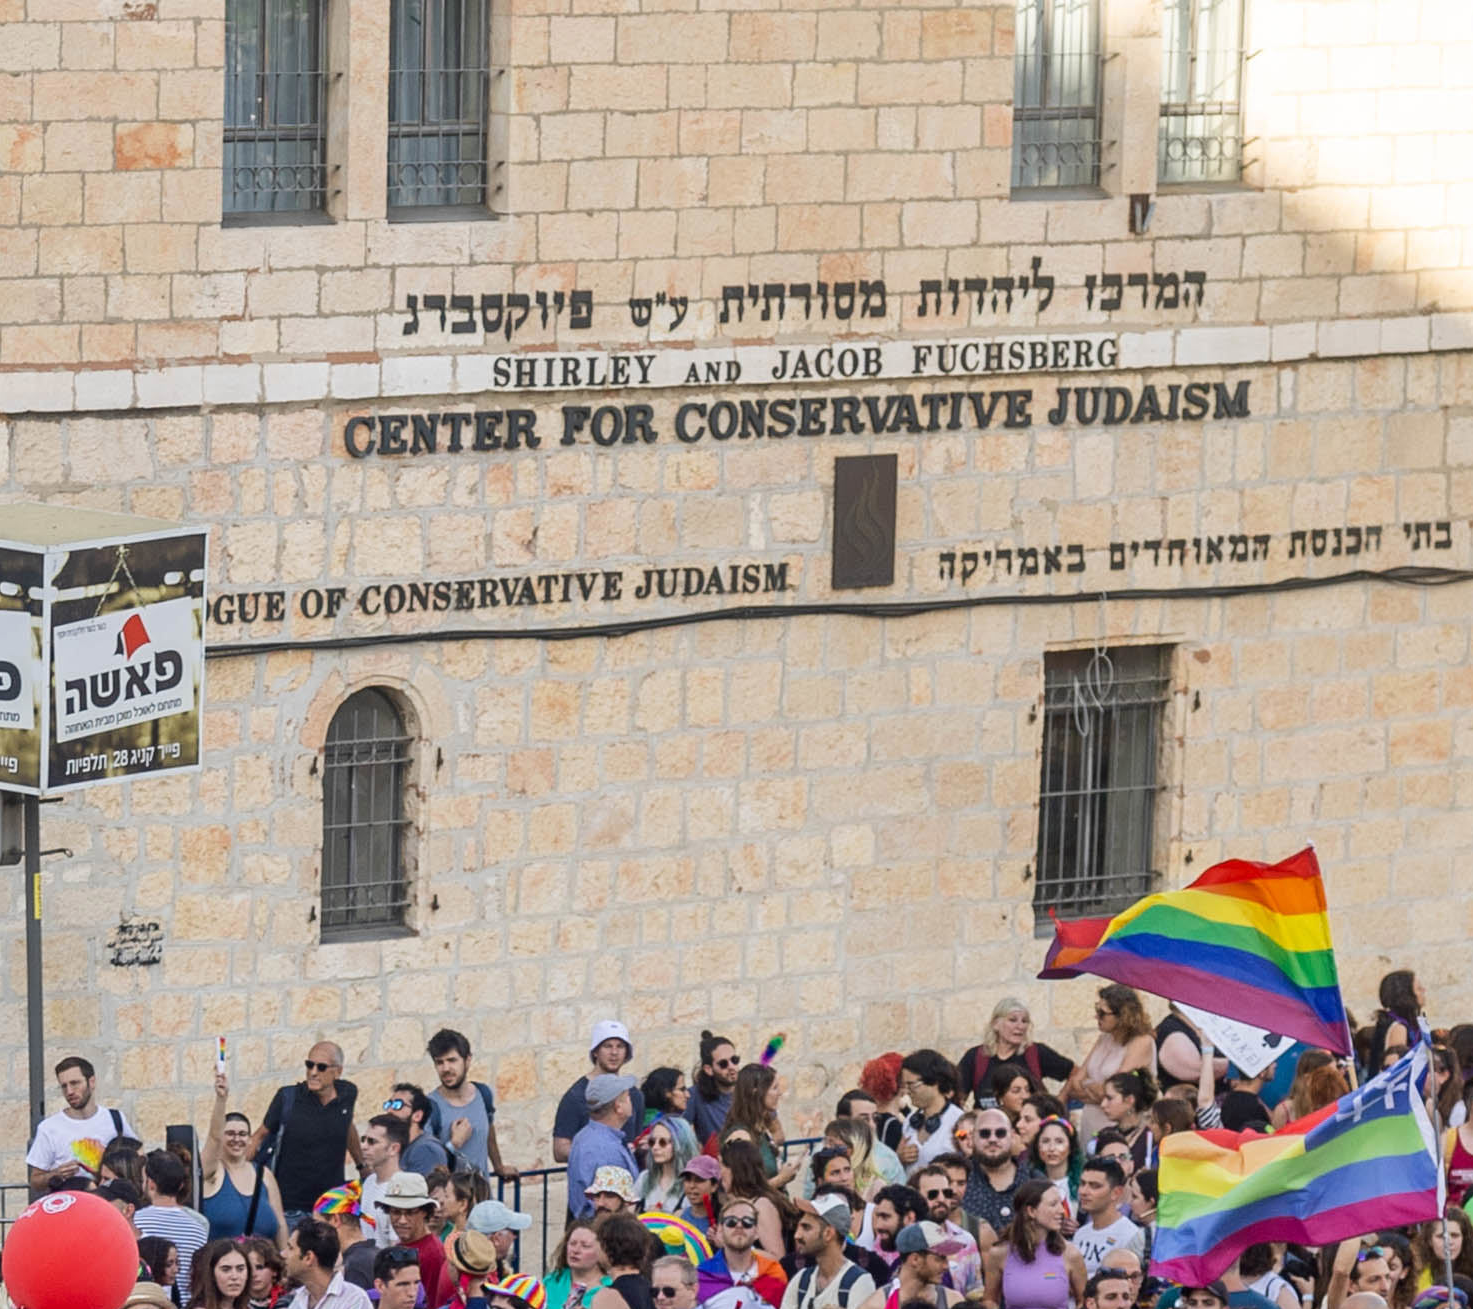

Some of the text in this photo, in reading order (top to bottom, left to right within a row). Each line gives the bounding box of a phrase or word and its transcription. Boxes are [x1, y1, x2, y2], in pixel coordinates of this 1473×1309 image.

[401, 256, 1207, 341] המרכז ליהדות מסורתית ע"ש פיוקסברג
[492, 337, 1119, 389] SHIRLEY AND JACOB FUCHSBERG
[343, 379, 1252, 460] CENTER FOR CONSERVATIVE JUDAISM
[938, 519, 1453, 588] בתי הכנסת המאוחדים באמריקה
[299, 586, 348, 620] OF
[358, 571, 624, 618] CONSERVATIVE
[634, 562, 791, 601] JUDAISM
[65, 650, 184, 716] פאשה
[64, 753, 107, 776] תלפיות
[129, 746, 157, 768] קניג
